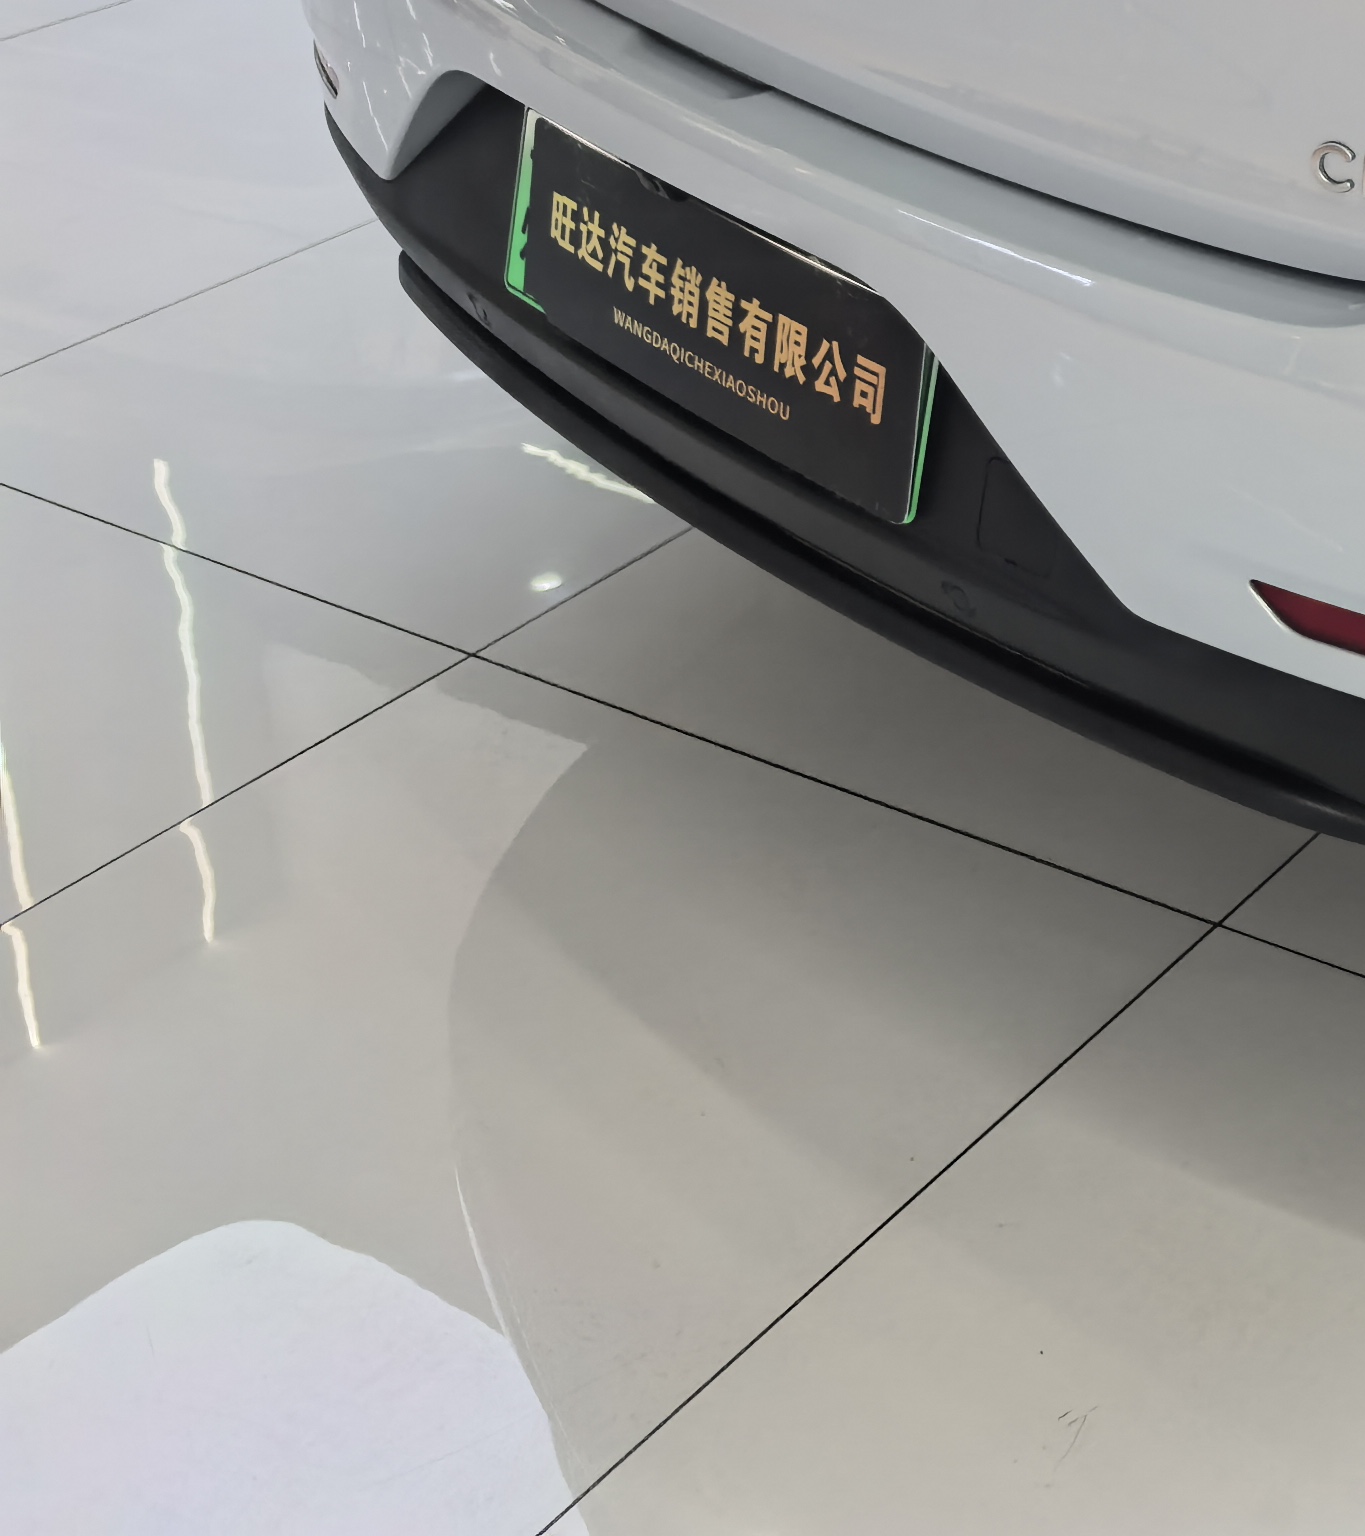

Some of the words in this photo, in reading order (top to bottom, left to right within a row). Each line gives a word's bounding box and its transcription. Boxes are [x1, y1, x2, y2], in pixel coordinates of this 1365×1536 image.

[549, 190, 887, 425] 旺达汽车销售有限公司
[612, 306, 792, 421] WANGDAQICHEXIAOSHOU
